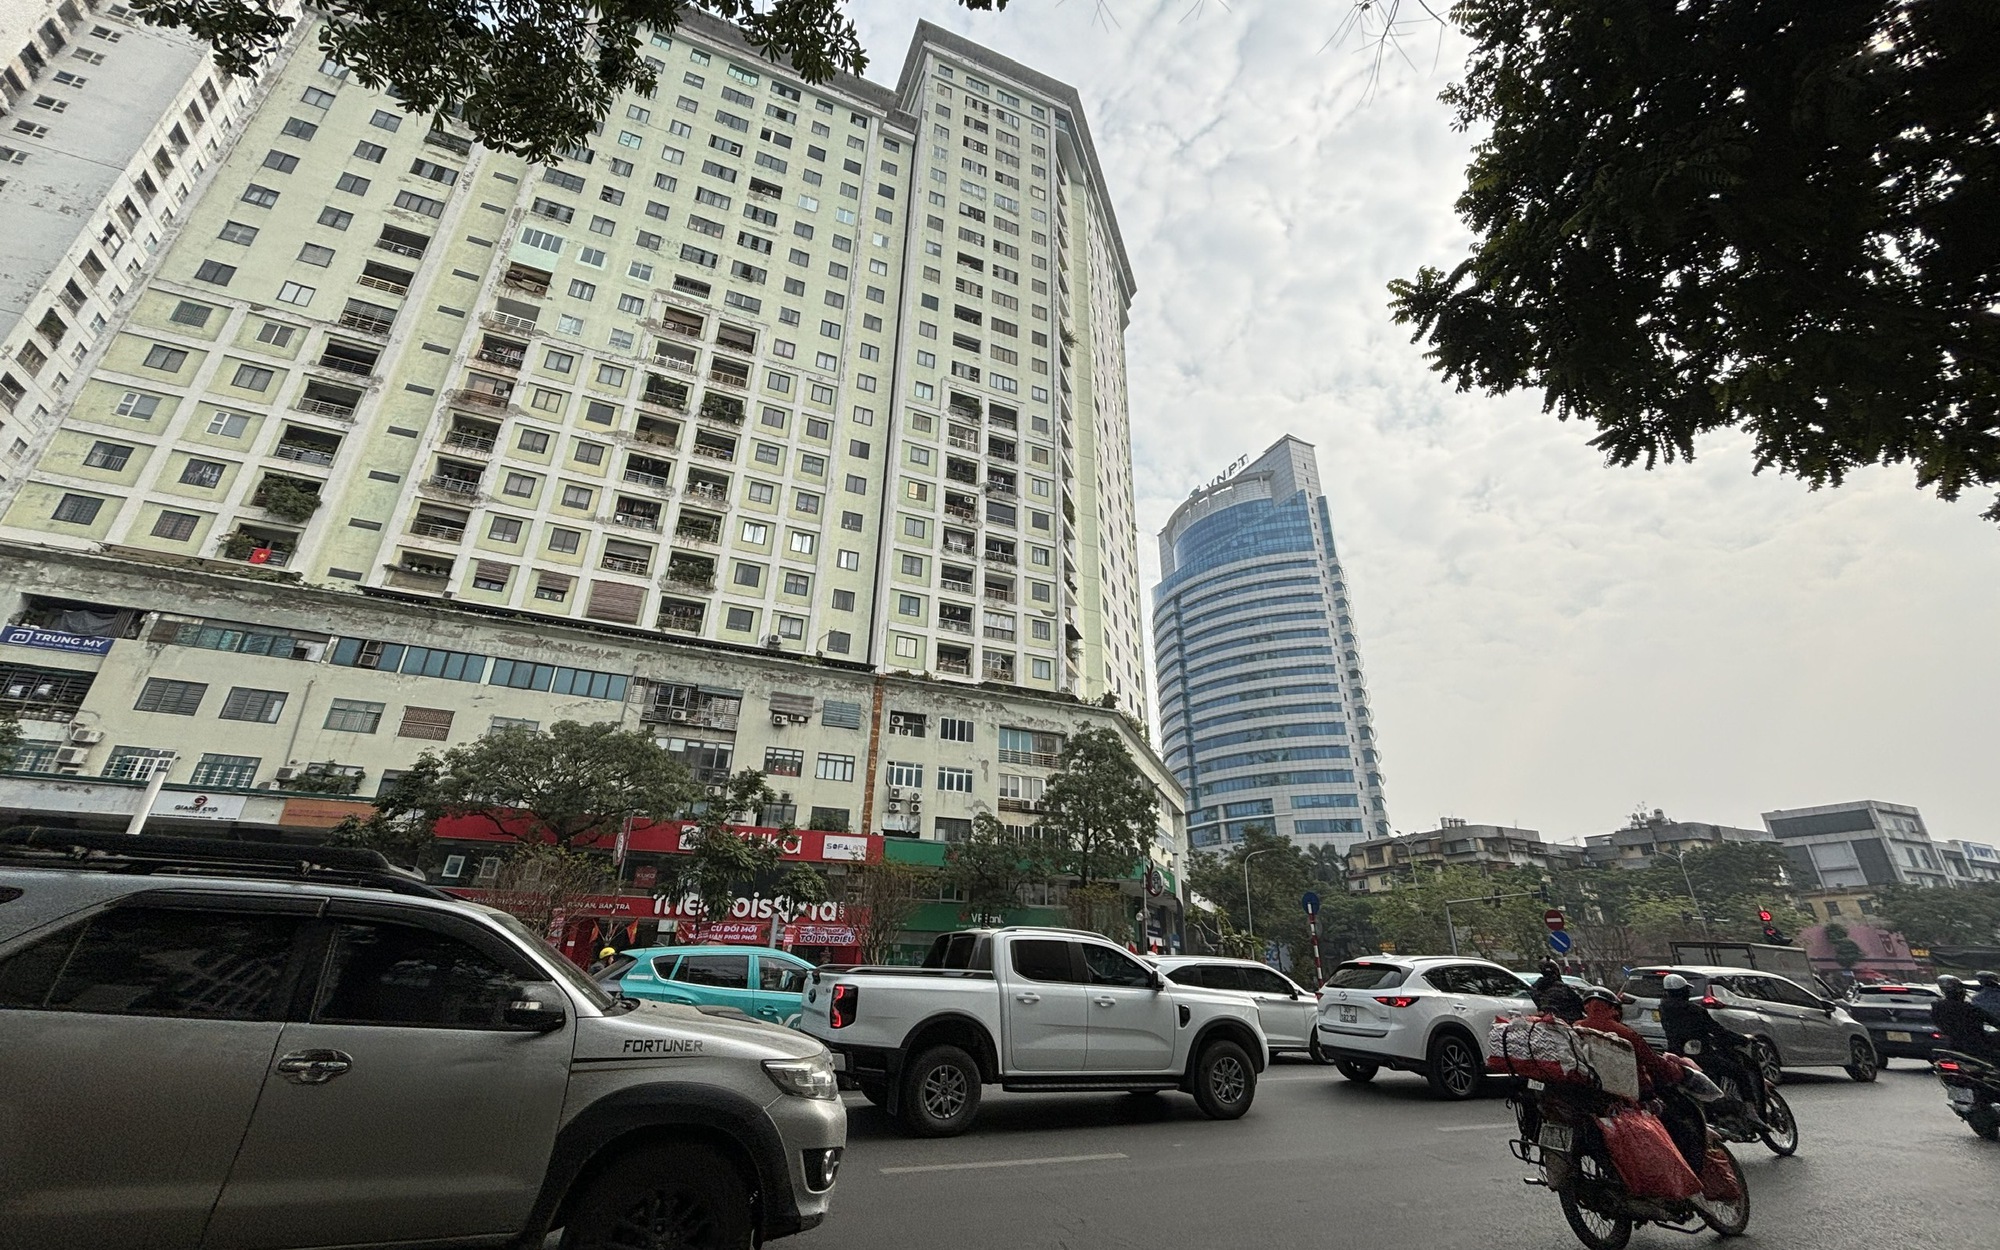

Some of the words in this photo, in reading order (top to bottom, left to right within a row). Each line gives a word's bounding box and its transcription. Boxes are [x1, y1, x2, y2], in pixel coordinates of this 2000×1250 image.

[1206, 453, 1248, 488] VNPT
[35, 633, 81, 645] TRUNG
[623, 1039, 703, 1053] FORTUNER
